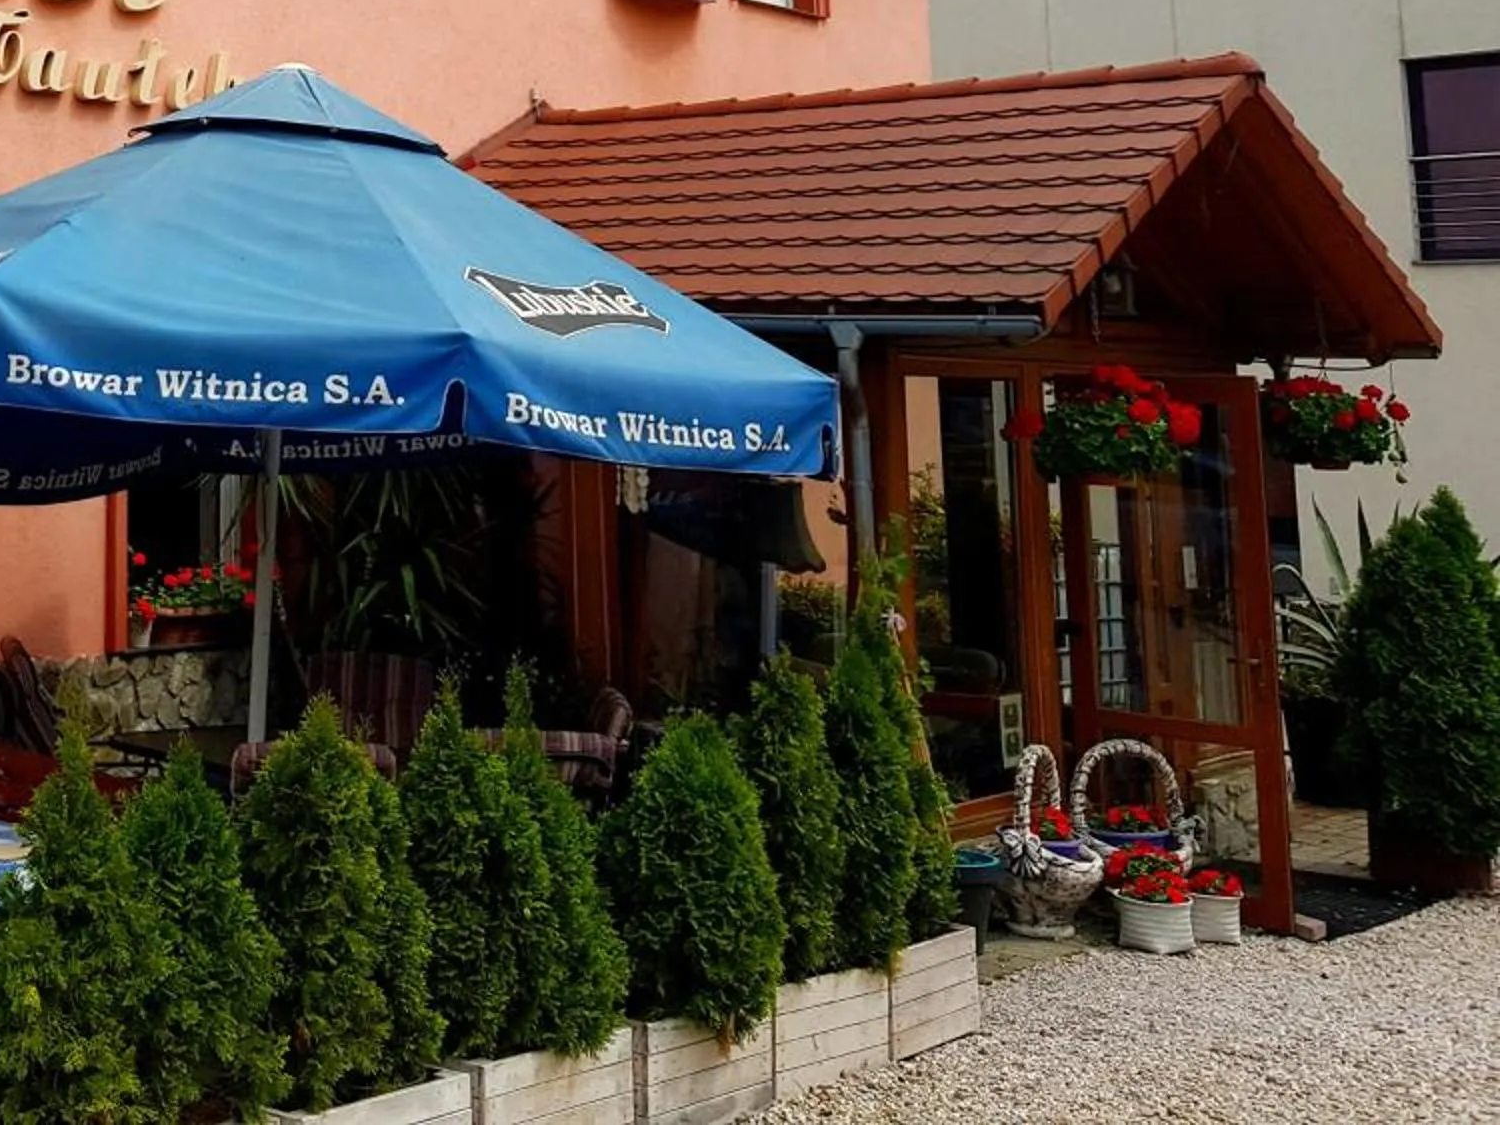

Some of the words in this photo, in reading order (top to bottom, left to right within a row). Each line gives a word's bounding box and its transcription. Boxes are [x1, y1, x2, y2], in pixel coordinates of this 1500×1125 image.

[6, 353, 143, 398] Browar
[156, 369, 308, 403] Witnica
[323, 374, 405, 405] S.A.
[505, 392, 608, 438] Browar
[617, 411, 735, 451] Witnica
[744, 423, 792, 452] S.A.
